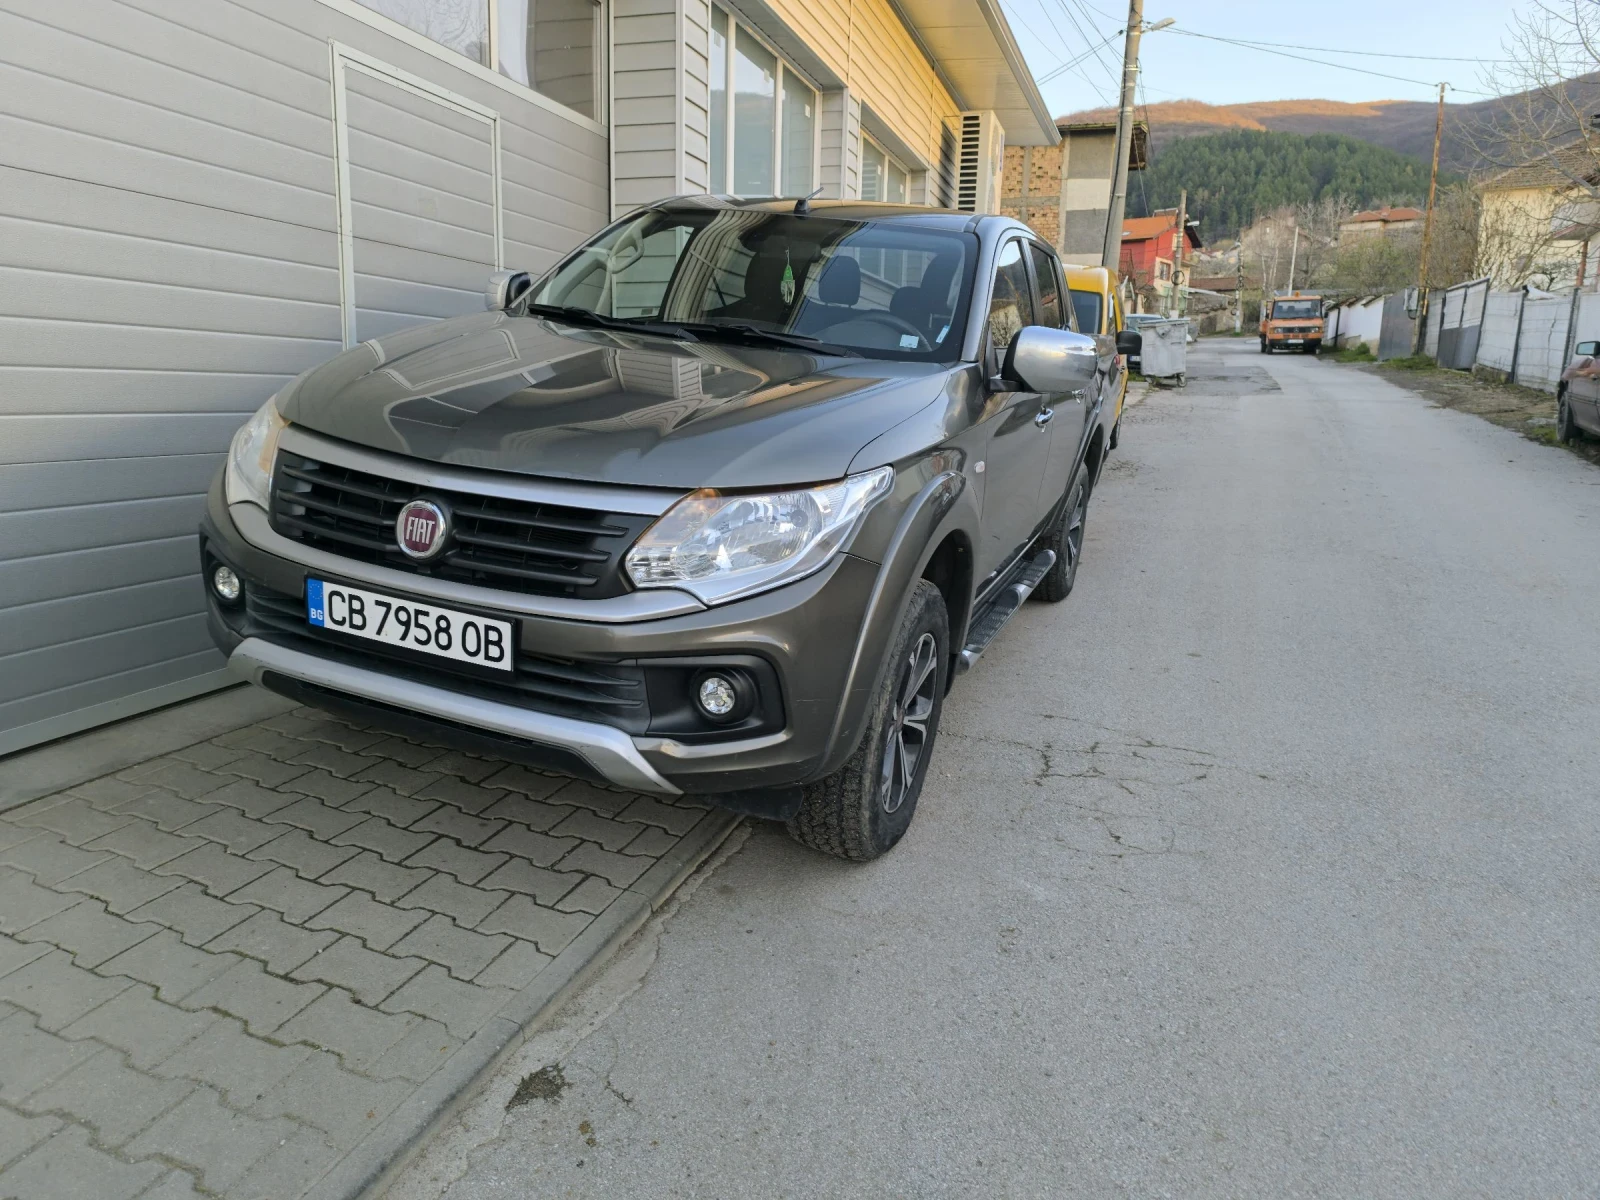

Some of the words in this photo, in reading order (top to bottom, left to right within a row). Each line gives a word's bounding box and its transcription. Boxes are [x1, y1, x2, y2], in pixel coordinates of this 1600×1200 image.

[407, 517, 435, 544] FIAT
[310, 608, 323, 620] BG
[327, 590, 367, 631] CB
[374, 599, 453, 651] 7958
[461, 621, 505, 663] OB
